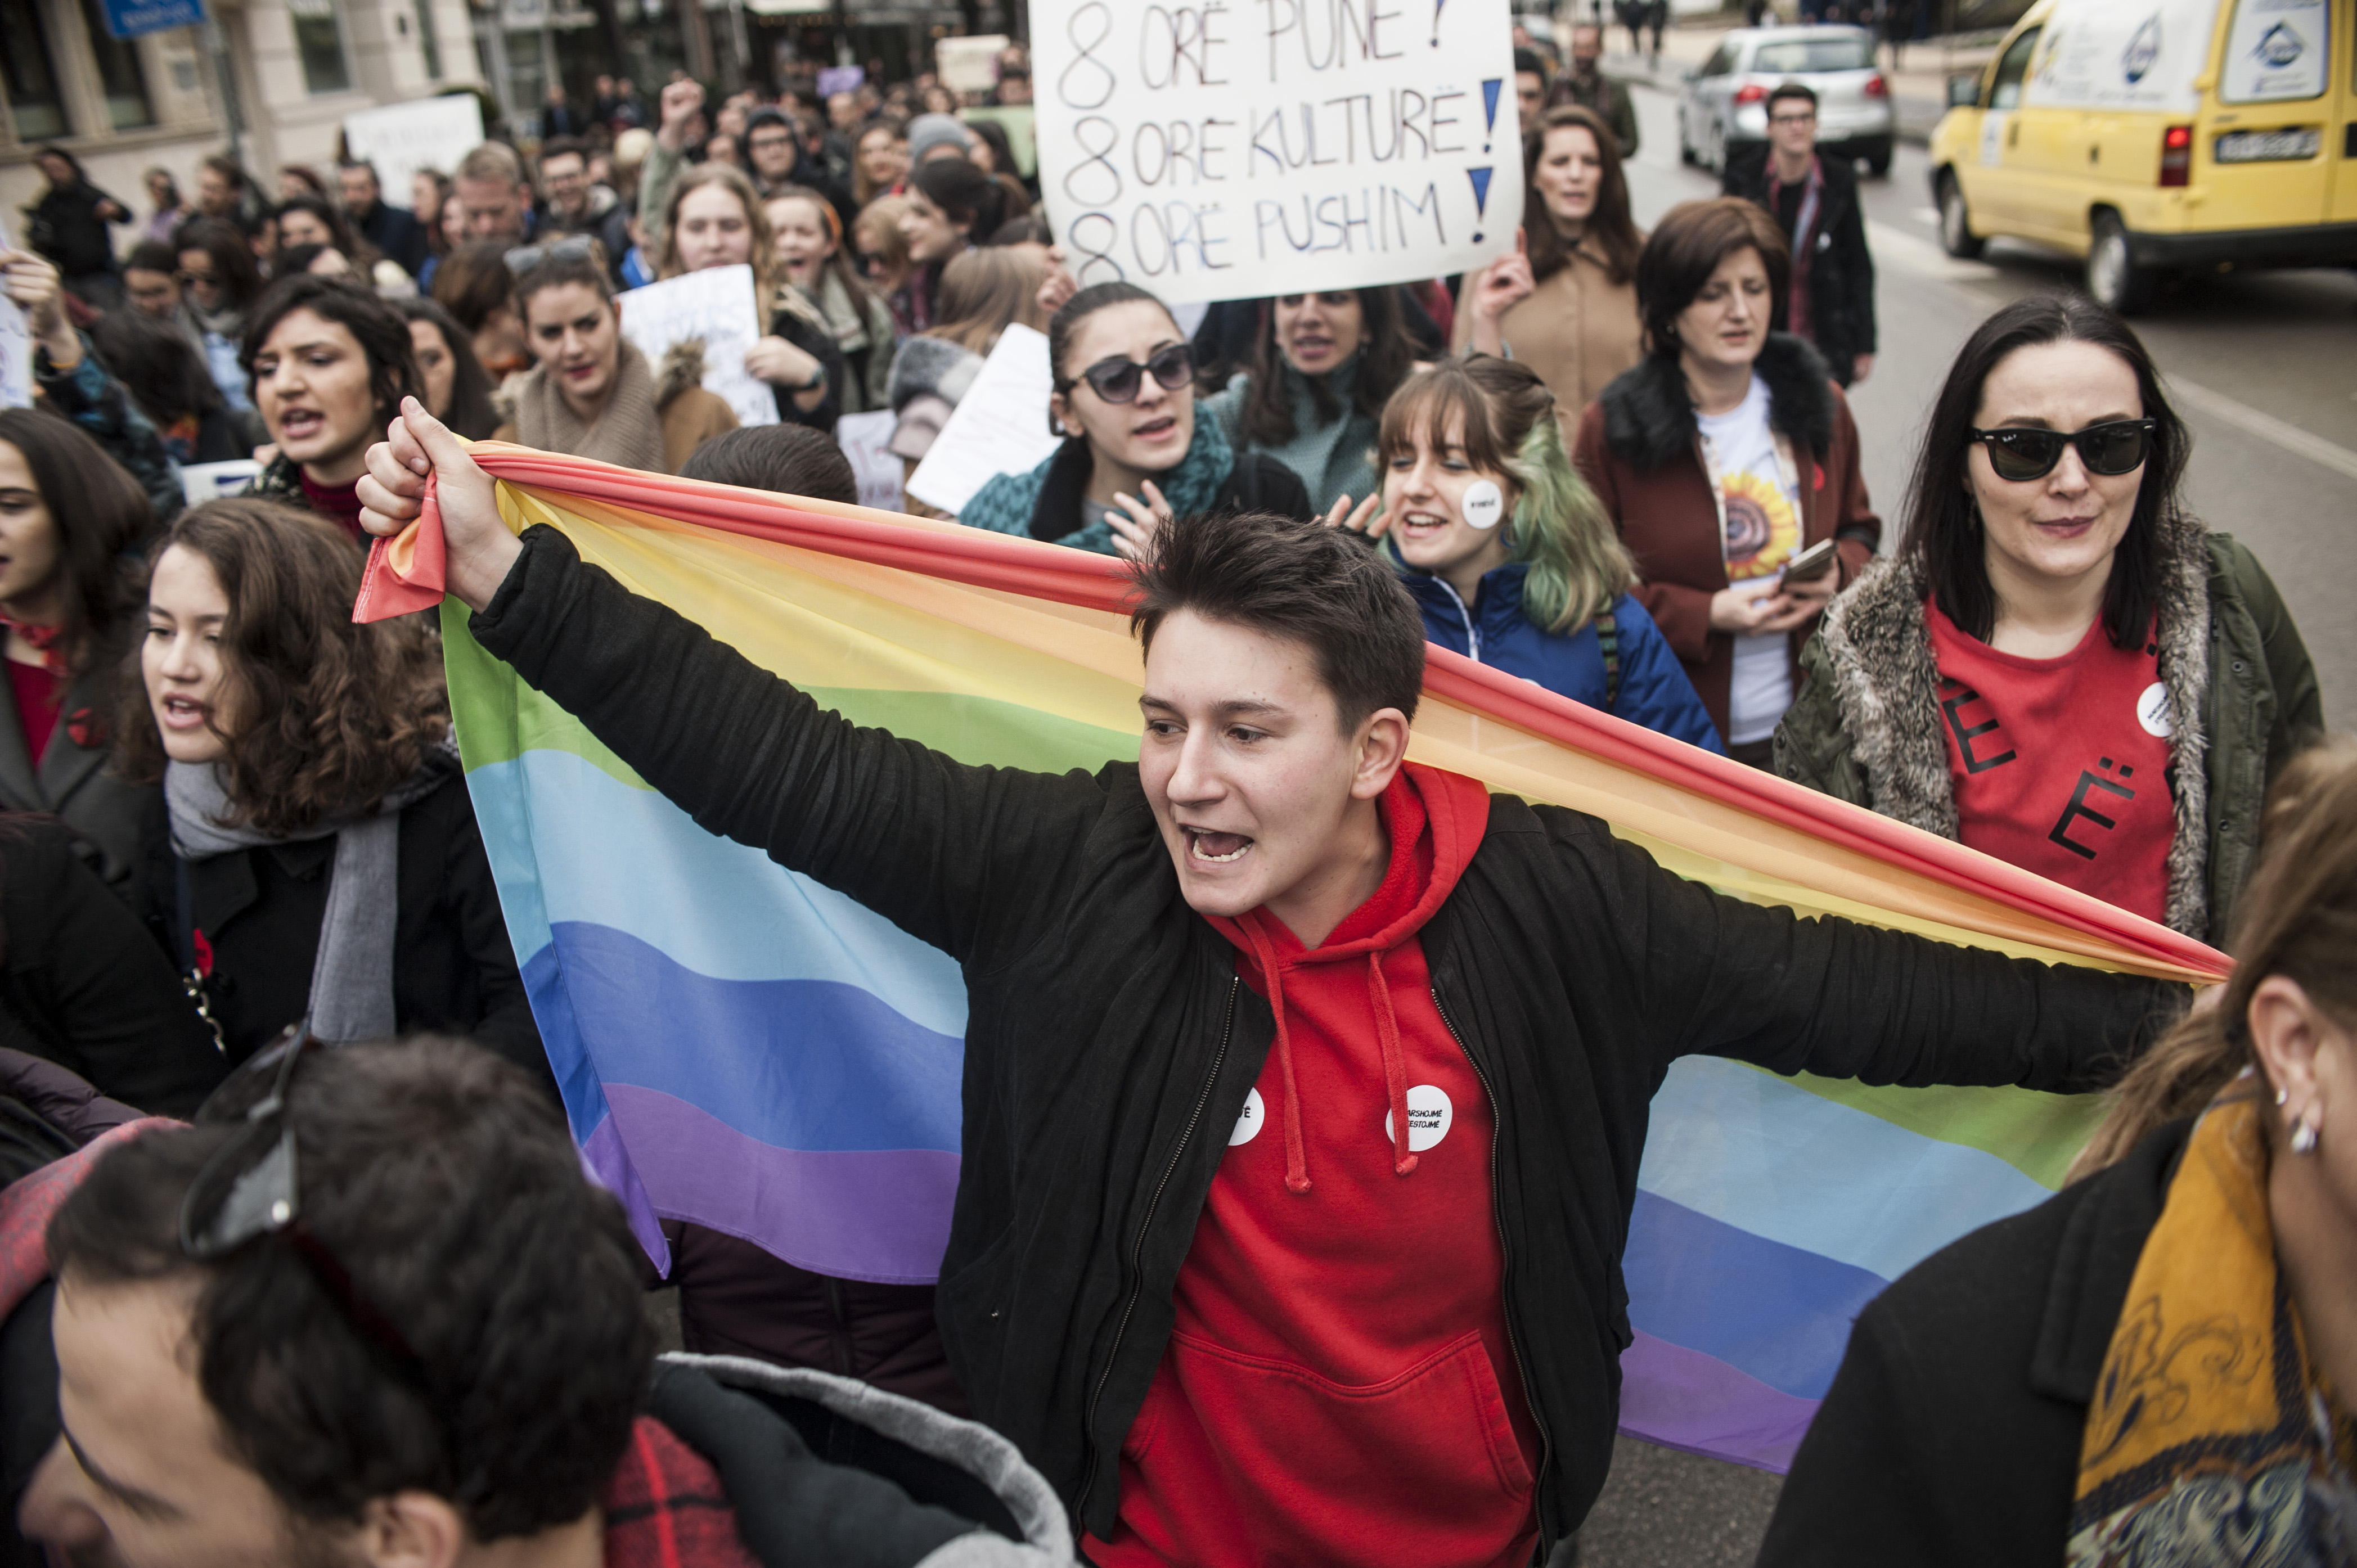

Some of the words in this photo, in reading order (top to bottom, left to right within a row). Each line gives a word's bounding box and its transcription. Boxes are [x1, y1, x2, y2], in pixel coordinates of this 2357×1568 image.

[1058, 1, 1115, 109] 8
[1139, 1, 1228, 90] ORË
[1063, 116, 1123, 208] 8
[1069, 211, 1124, 289] 8
[1131, 202, 1233, 276] ORË
[2048, 756, 2135, 860] Ë
